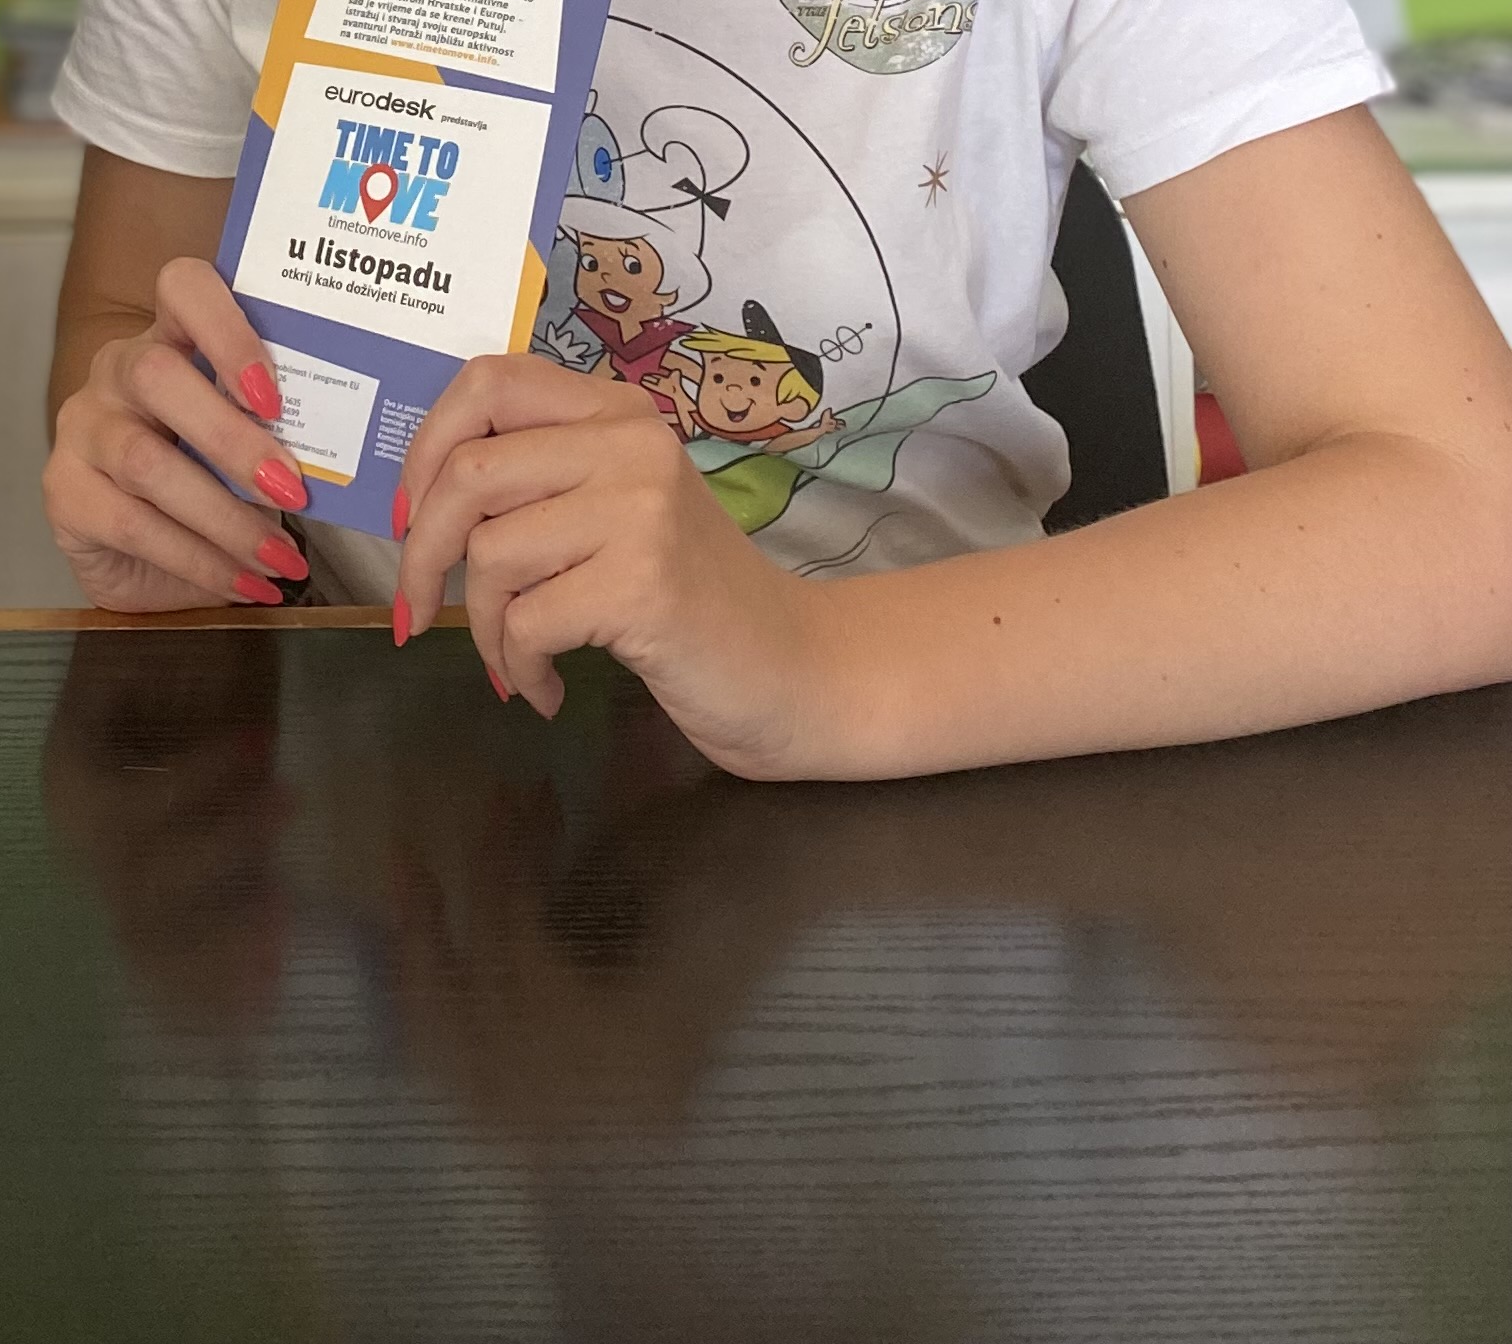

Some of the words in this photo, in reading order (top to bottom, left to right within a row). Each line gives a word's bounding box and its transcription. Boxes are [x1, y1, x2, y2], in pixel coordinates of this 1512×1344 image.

[377, 1, 412, 15] vrijeme
[413, 6, 427, 17] da
[428, 10, 441, 20] se
[479, 6, 516, 22] Europe
[339, 30, 351, 38] na
[353, 31, 388, 45] stranici
[387, 14, 420, 29] stvaraj
[421, 20, 448, 33] svoju
[449, 26, 497, 42] europsku
[466, 40, 515, 58] aktivnost
[324, 85, 437, 121] eurodesk
[439, 114, 487, 131] predstavlja
[334, 118, 415, 172] TIME
[417, 134, 460, 180] TO
[327, 214, 428, 248] timetomove.info
[287, 237, 306, 261] u
[314, 236, 452, 294] listopadu
[280, 267, 313, 286] otkrij
[314, 272, 343, 290] kako
[345, 280, 397, 303] doživjeti
[399, 292, 445, 315] Europu
[348, 380, 360, 391] EU
